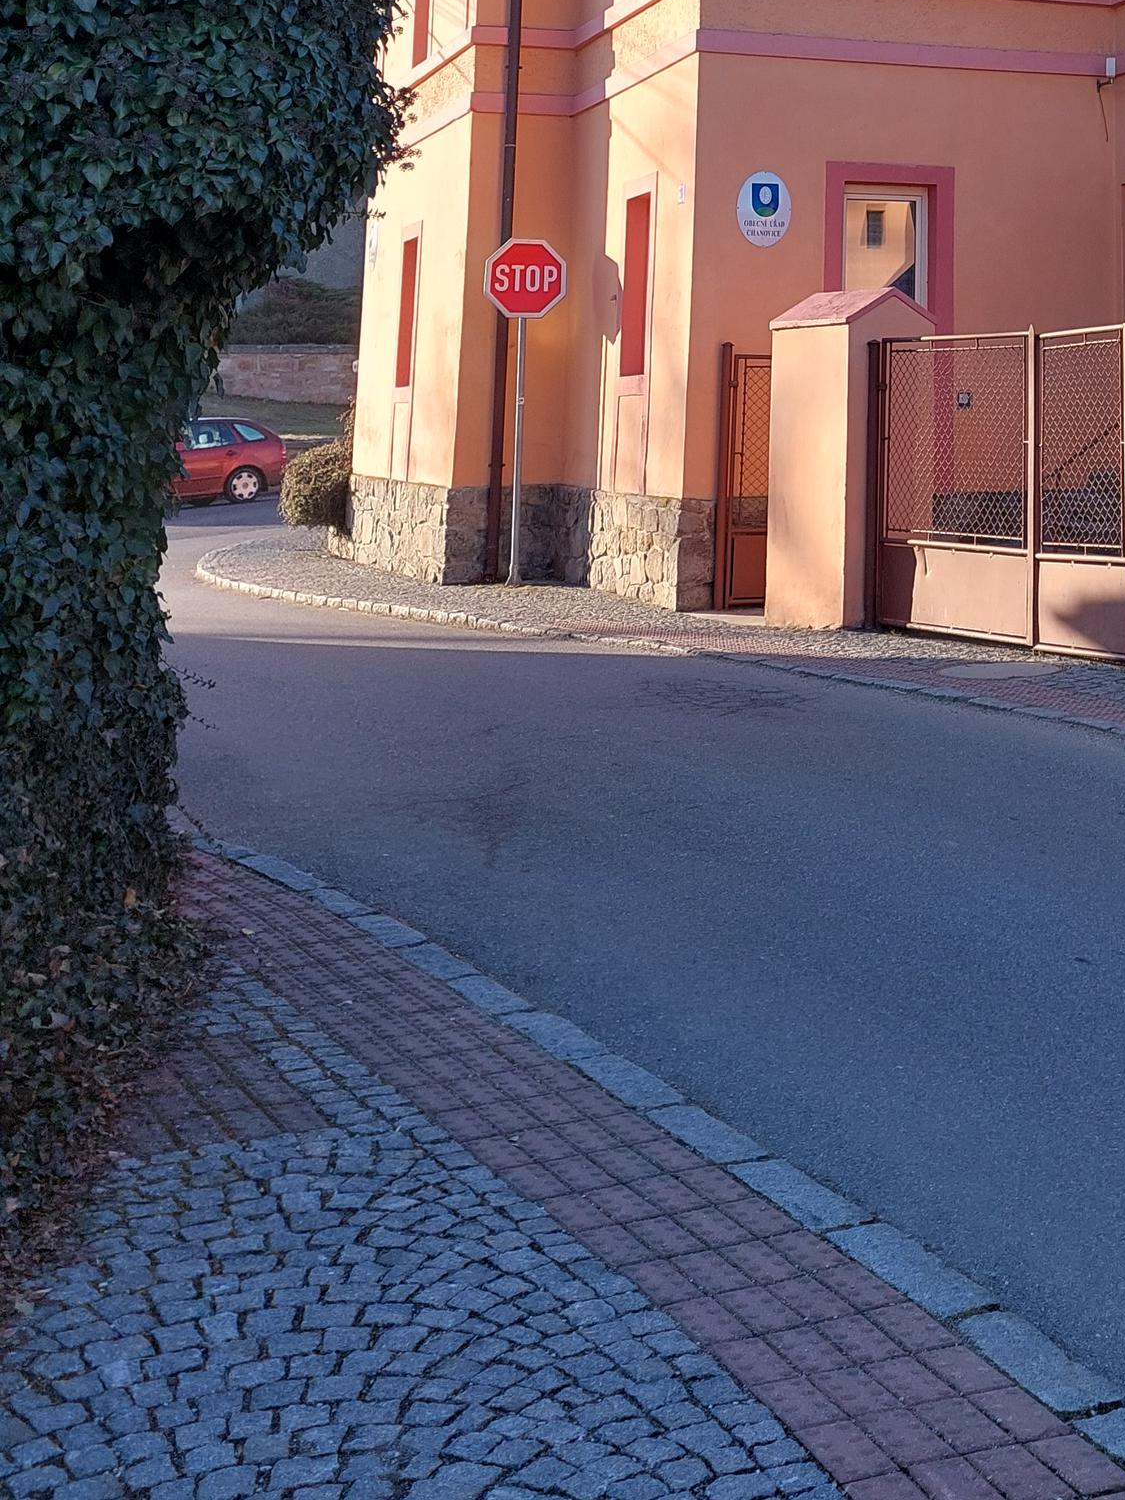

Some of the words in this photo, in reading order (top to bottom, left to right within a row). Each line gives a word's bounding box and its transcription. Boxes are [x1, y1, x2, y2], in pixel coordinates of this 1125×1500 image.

[743, 219, 767, 227] OBECNÍ
[746, 229, 781, 237] CHANOVICE
[494, 264, 558, 292] STOP
